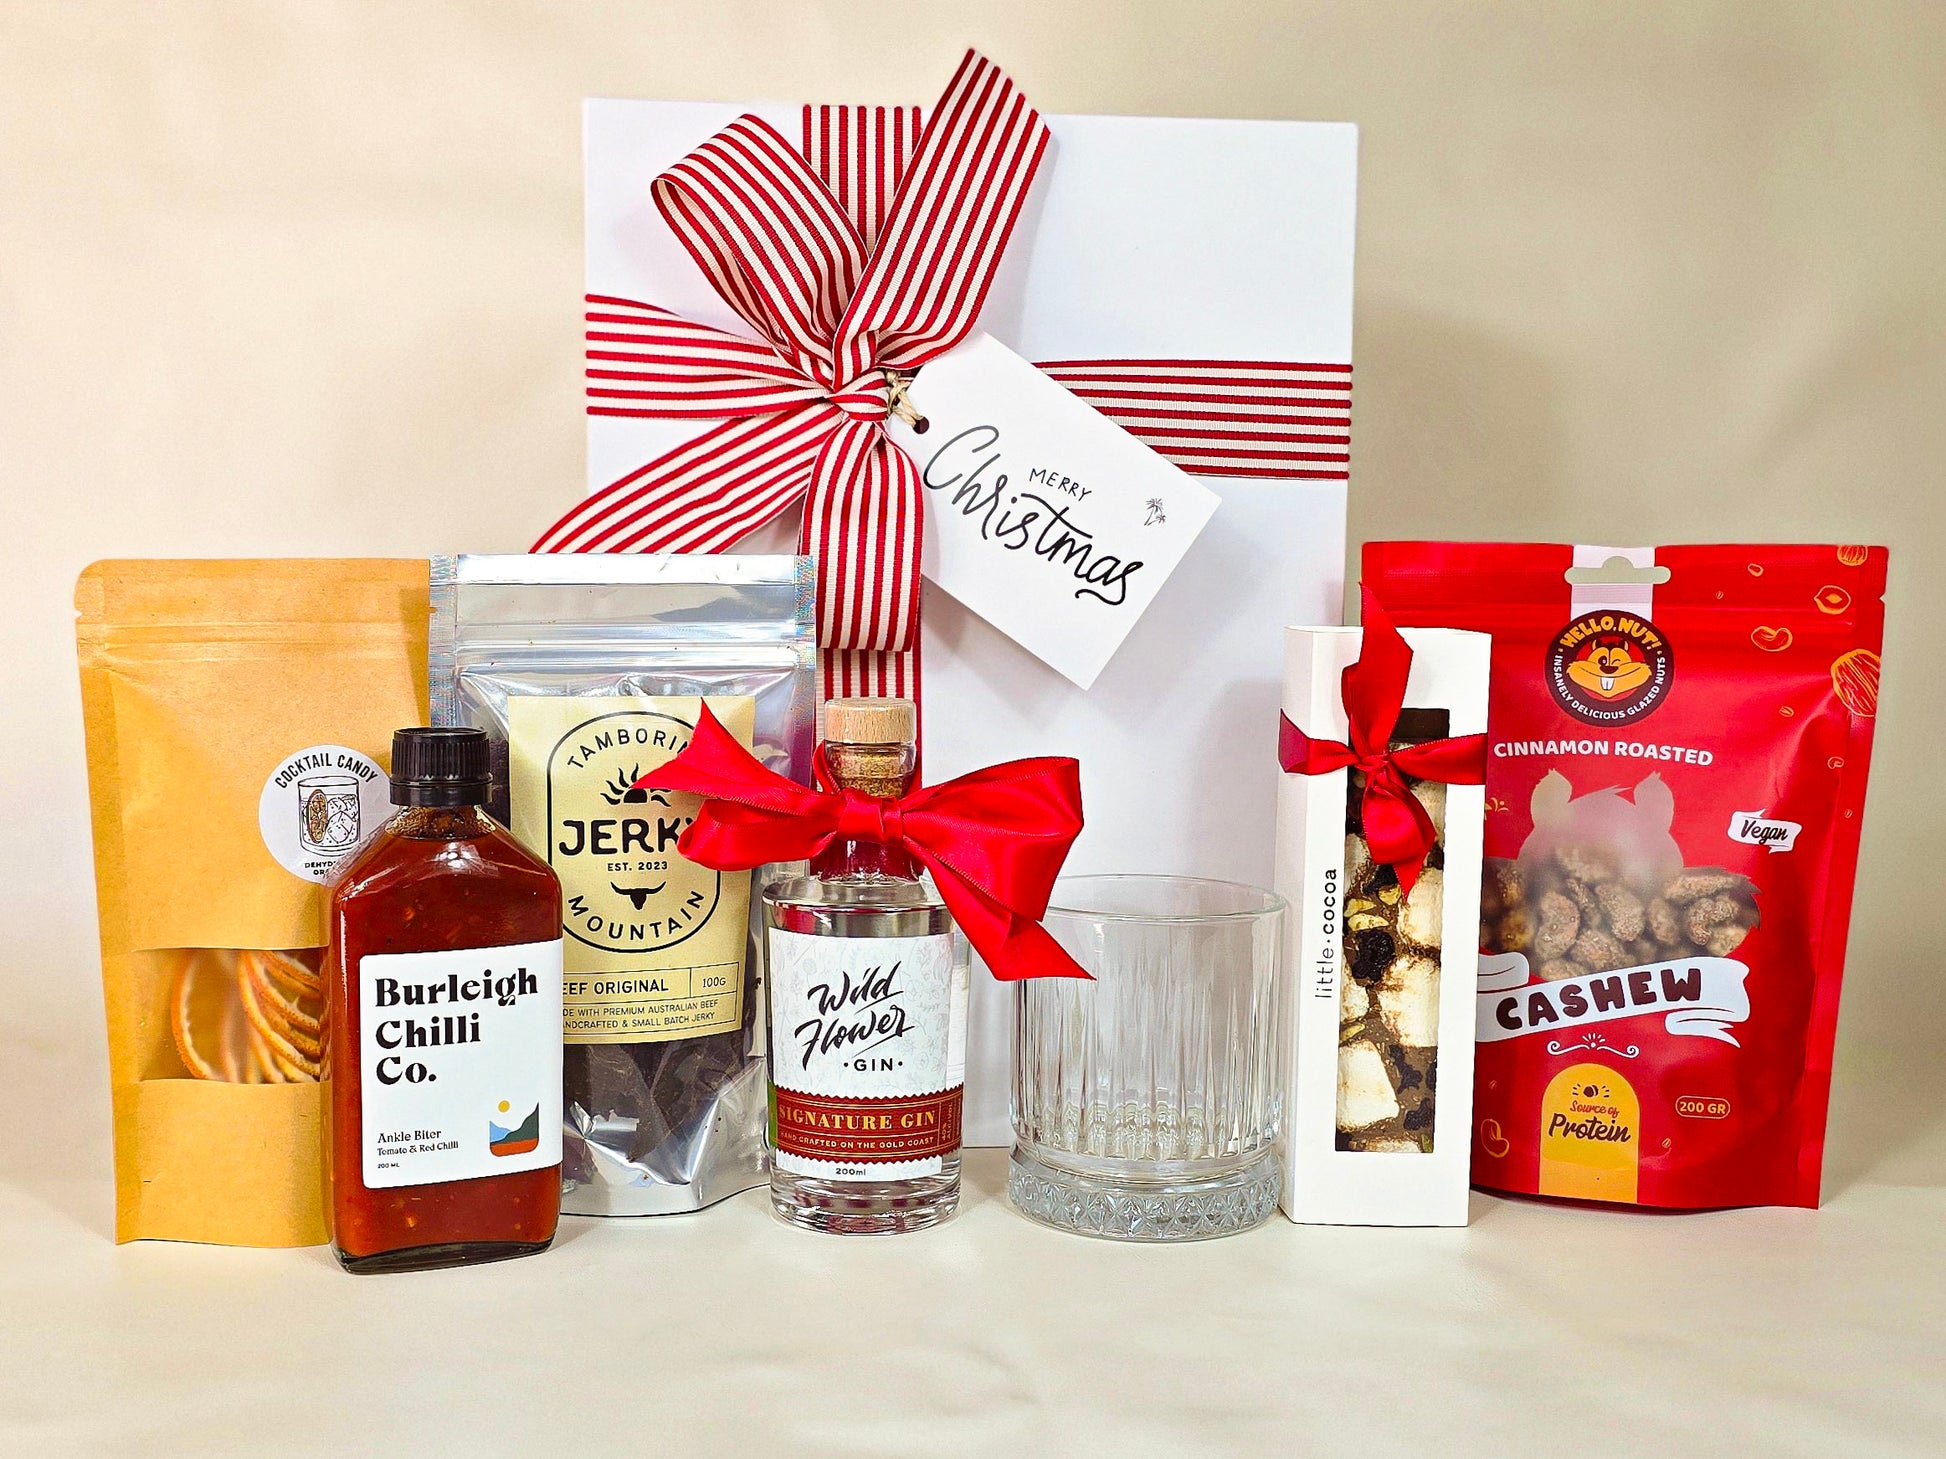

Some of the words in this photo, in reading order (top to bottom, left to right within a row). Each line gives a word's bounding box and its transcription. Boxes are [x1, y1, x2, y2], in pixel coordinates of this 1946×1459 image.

[1028, 468, 1092, 502] MERRY
[923, 425, 1144, 606] Christmas
[1618, 617, 1662, 651] NUT!
[1553, 654, 1574, 701] INSANELY
[1572, 702, 1625, 719] DELICIOUS
[1626, 685, 1660, 716] GLAZED
[1655, 656, 1666, 685] NUTS
[567, 727, 692, 769] TAMBORI
[1493, 739, 1609, 758] CINNAMON
[1614, 741, 1713, 766] ROASTED
[274, 753, 332, 789] COCKTAIL
[337, 754, 378, 783] CANDY
[558, 817, 695, 856] JERK
[1739, 818, 1789, 845] Vegan
[607, 862, 632, 872] EST.
[638, 861, 668, 871] 2023
[568, 890, 705, 941] MOUNTAIN
[375, 968, 538, 1007] Burleigh
[563, 982, 588, 995] EEF
[594, 978, 669, 994] ORIGINAL
[702, 976, 726, 988] 100G
[807, 961, 904, 1015] Wild
[578, 1008, 600, 1017] WITH
[603, 1006, 645, 1016] PREMIUM
[648, 1002, 698, 1014] AUSTRALIAN
[700, 999, 719, 1009] BEEF
[1495, 968, 1702, 1031] CASHEW
[375, 1012, 481, 1049] Chilli
[563, 1020, 619, 1029] NDCRAFTED
[622, 1019, 628, 1028] &
[631, 1018, 661, 1027] SMALL
[664, 1015, 690, 1025] BATCH
[692, 1012, 715, 1023] JERKY
[794, 1004, 916, 1072] Flower
[376, 1056, 437, 1085] Co.
[778, 1105, 892, 1130] SIGNATURE
[901, 1110, 936, 1128] GIN
[1569, 1100, 1607, 1115] Source
[1607, 1106, 1620, 1118] of
[1679, 1101, 1704, 1113] 200
[1707, 1103, 1726, 1115] GR
[377, 1131, 411, 1144] Ankle
[414, 1129, 442, 1141] Biter
[799, 1136, 837, 1148] CRAFTED
[840, 1141, 855, 1149] ON
[857, 1141, 875, 1149] THE
[879, 1140, 905, 1148] GOLD
[907, 1136, 934, 1147] COAST
[1548, 1113, 1631, 1143] Protein
[377, 1147, 408, 1156] Tomato
[409, 1145, 417, 1154] &
[419, 1143, 435, 1152] Red
[436, 1141, 459, 1151] Chilli
[835, 1167, 866, 1176] 200ml
